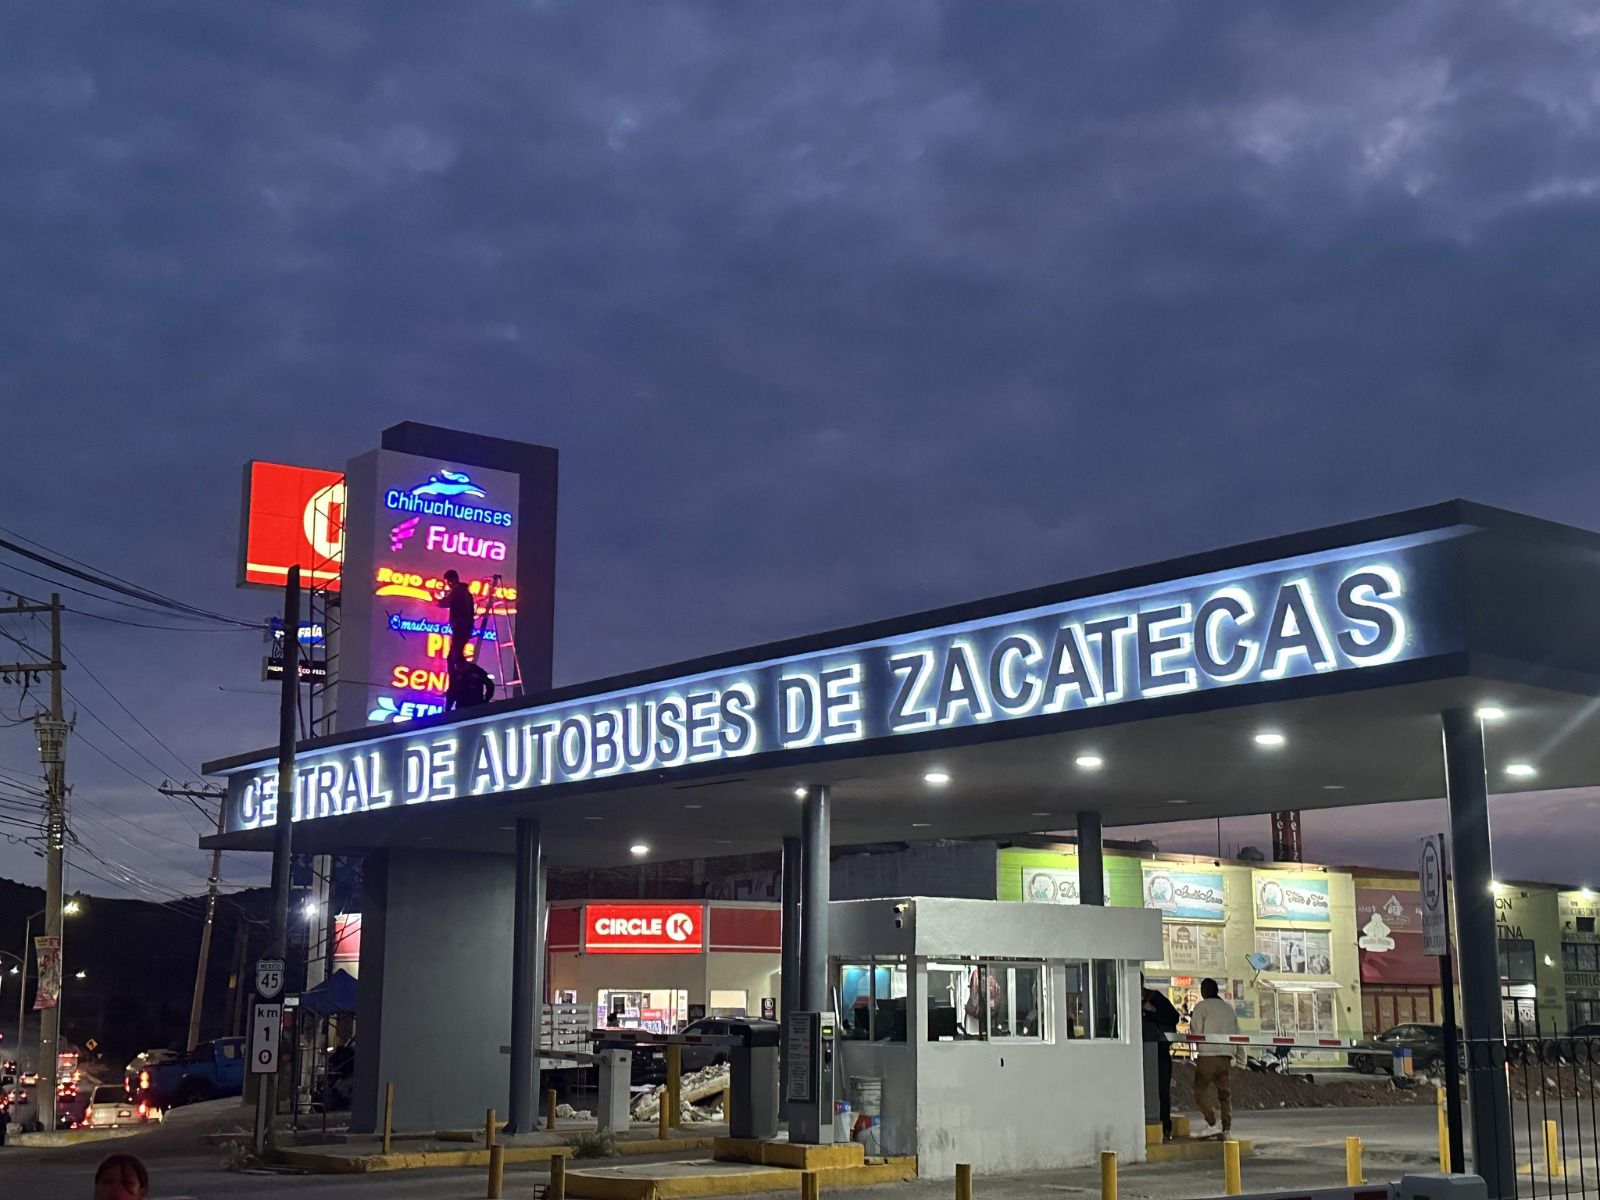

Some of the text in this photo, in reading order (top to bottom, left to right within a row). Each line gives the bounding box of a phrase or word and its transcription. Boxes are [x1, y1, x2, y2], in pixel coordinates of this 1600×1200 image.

[387, 490, 512, 527] Chihuahuenses
[426, 525, 507, 560] Futura
[402, 740, 456, 805] DE
[471, 684, 755, 796] AUTOBUSES
[778, 664, 861, 748] DE
[888, 566, 1402, 732] ZACATECAS
[595, 917, 692, 939] CIRCLE K
[261, 973, 279, 989] 45
[257, 1007, 278, 1018] km
[263, 1026, 271, 1042] 1
